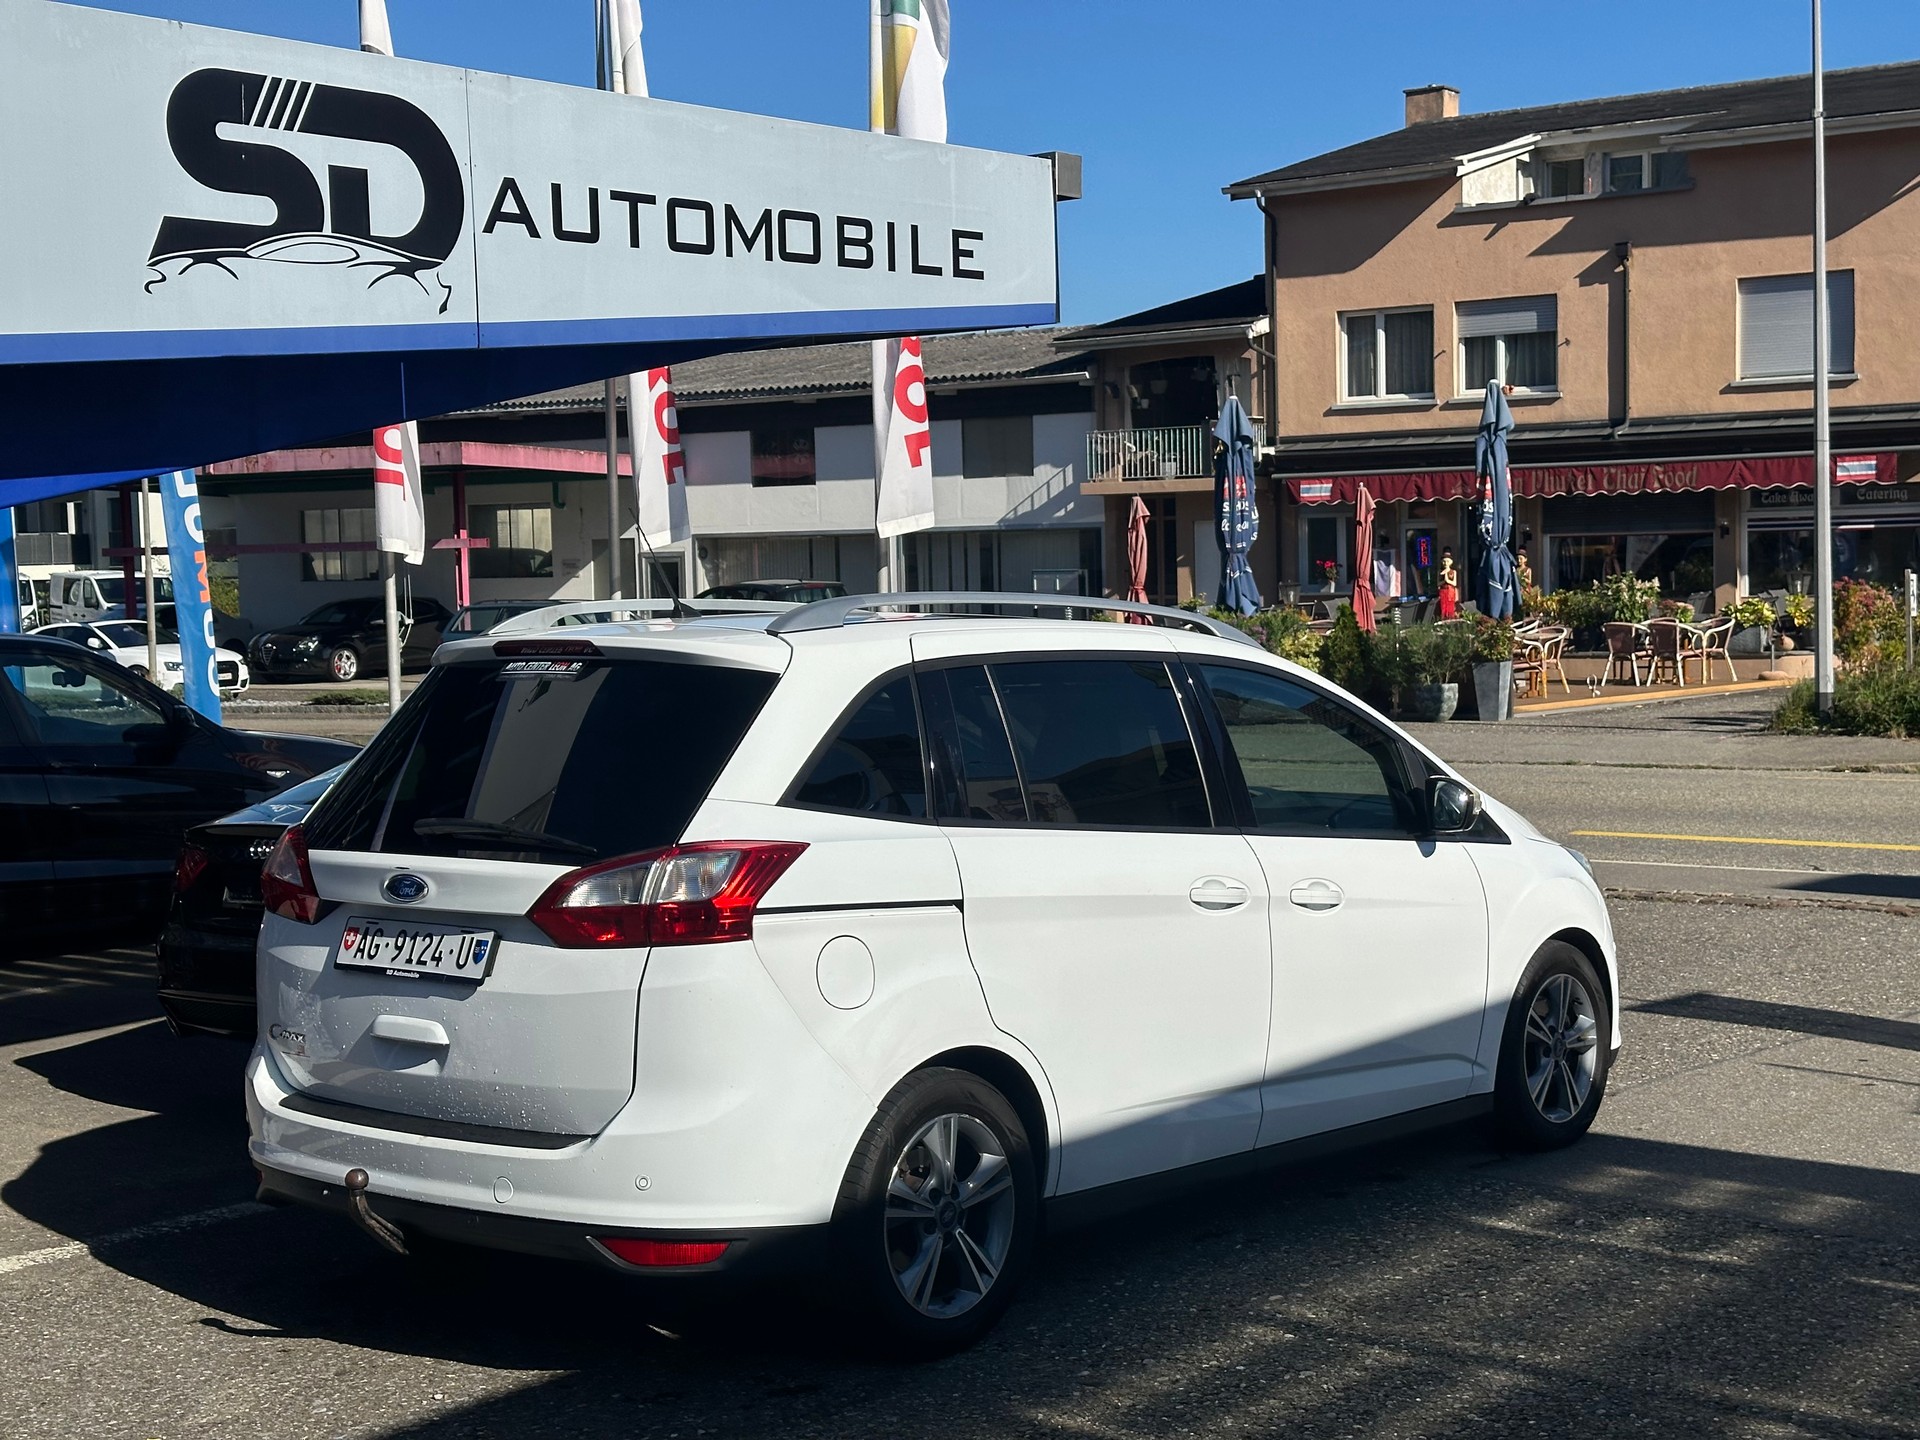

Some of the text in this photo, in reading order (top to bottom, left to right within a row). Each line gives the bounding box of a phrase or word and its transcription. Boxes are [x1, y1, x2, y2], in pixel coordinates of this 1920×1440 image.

[147, 67, 985, 280] SD AUTOMOBILE
[1602, 466, 1646, 490] Thai
[1652, 463, 1698, 488] Food
[1761, 491, 1814, 505] Take Awa
[1856, 488, 1909, 501] Catering
[506, 661, 583, 672] AUTO CENTER LEON AG
